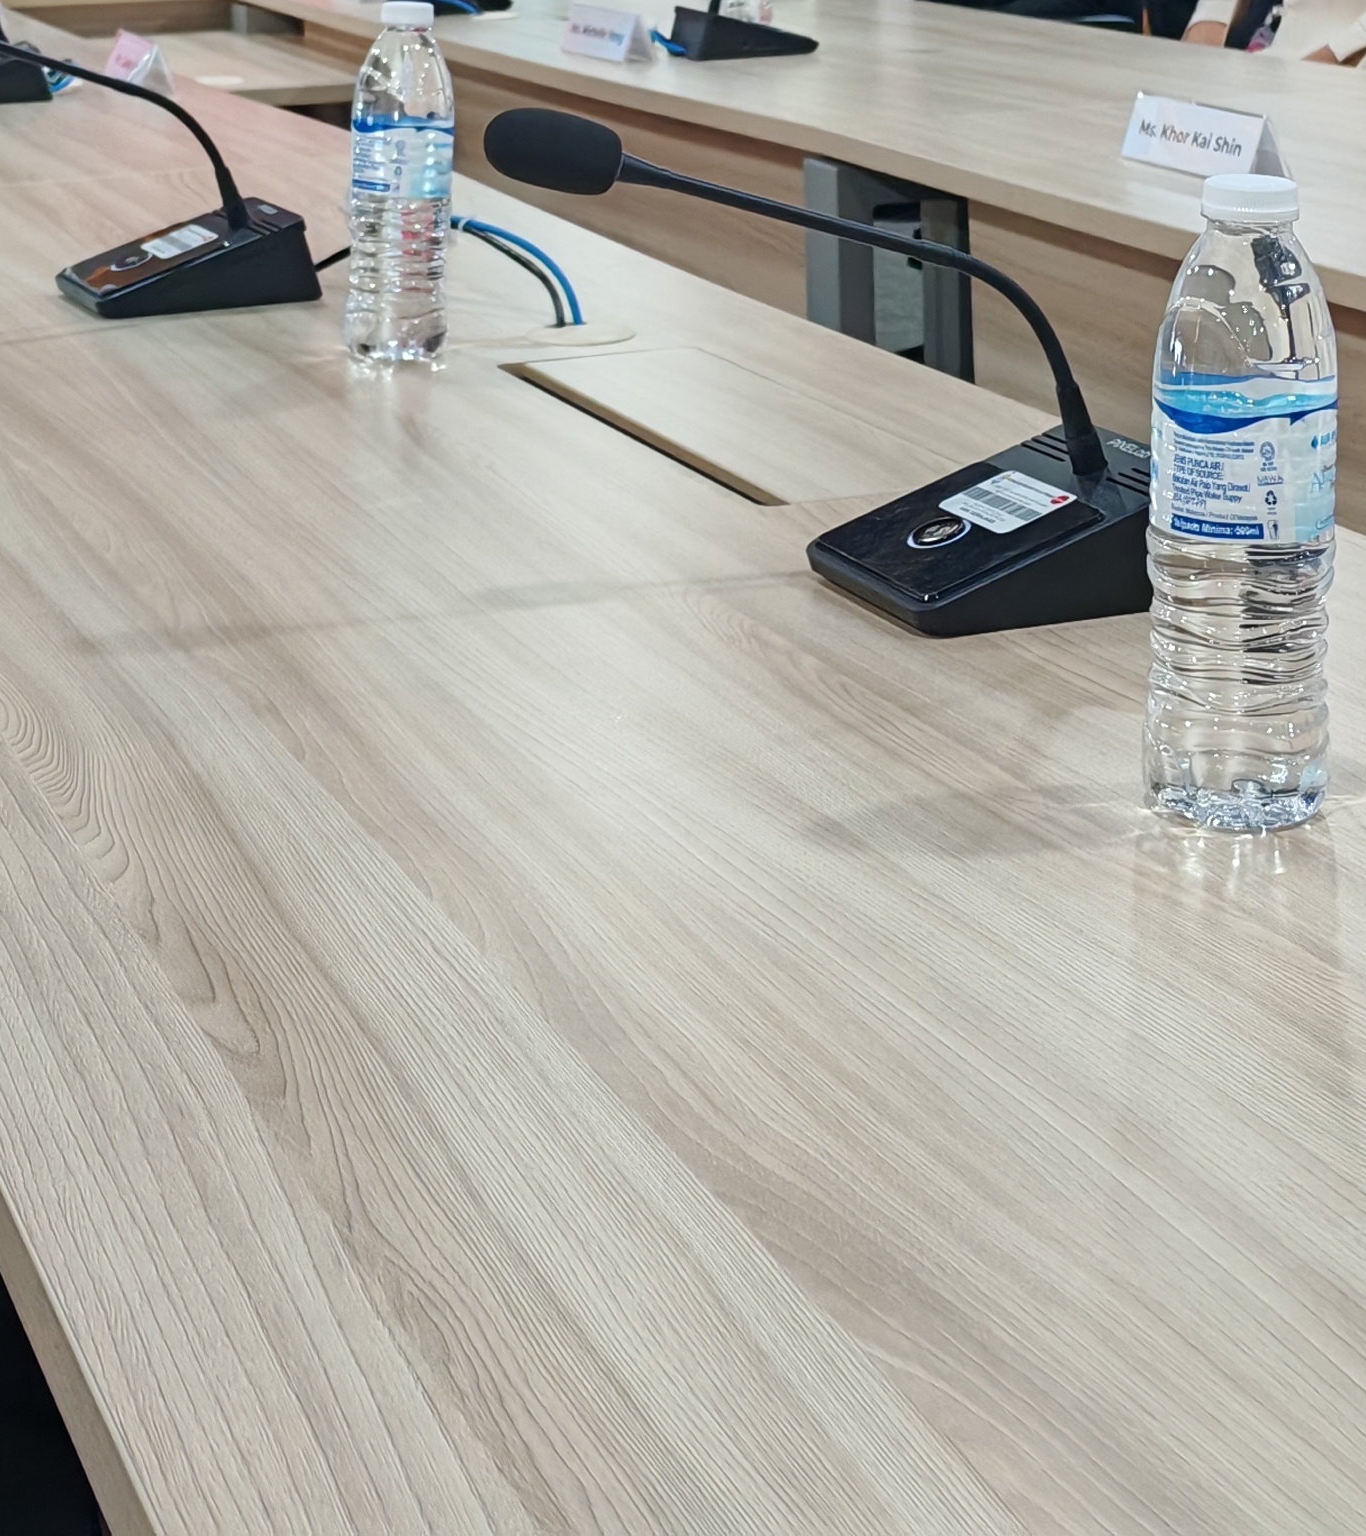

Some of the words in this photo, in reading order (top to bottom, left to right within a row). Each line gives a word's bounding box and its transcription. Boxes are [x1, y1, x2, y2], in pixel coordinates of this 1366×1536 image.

[1160, 123, 1189, 145] Khor
[1191, 130, 1212, 150] Kai
[1212, 135, 1243, 158] Shin
